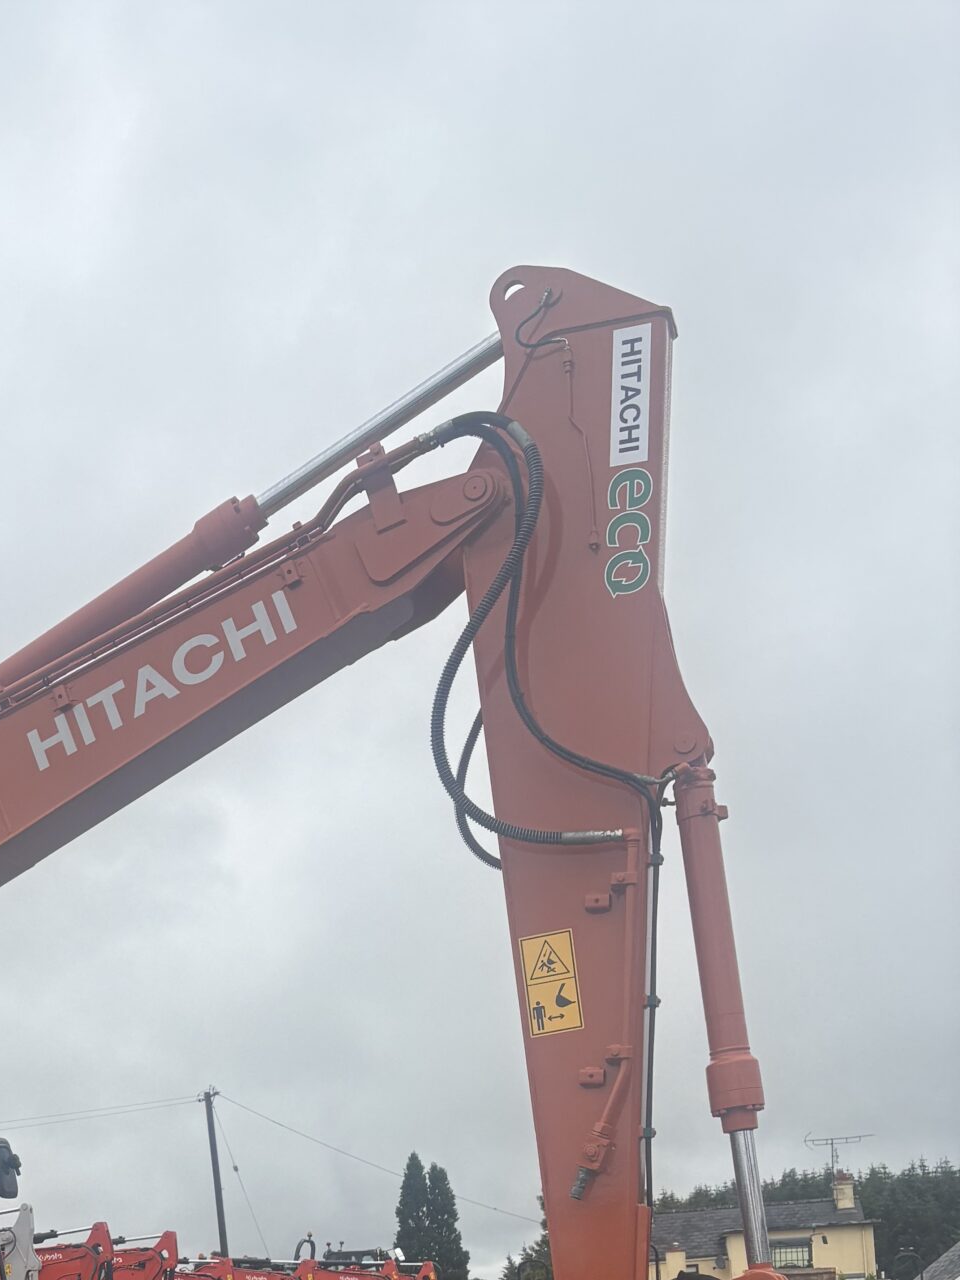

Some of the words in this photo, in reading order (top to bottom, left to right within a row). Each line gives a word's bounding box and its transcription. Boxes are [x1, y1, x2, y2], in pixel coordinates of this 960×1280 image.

[618, 336, 644, 454] HITACHI
[605, 467, 653, 598] eco
[27, 590, 297, 771] HITACHI
